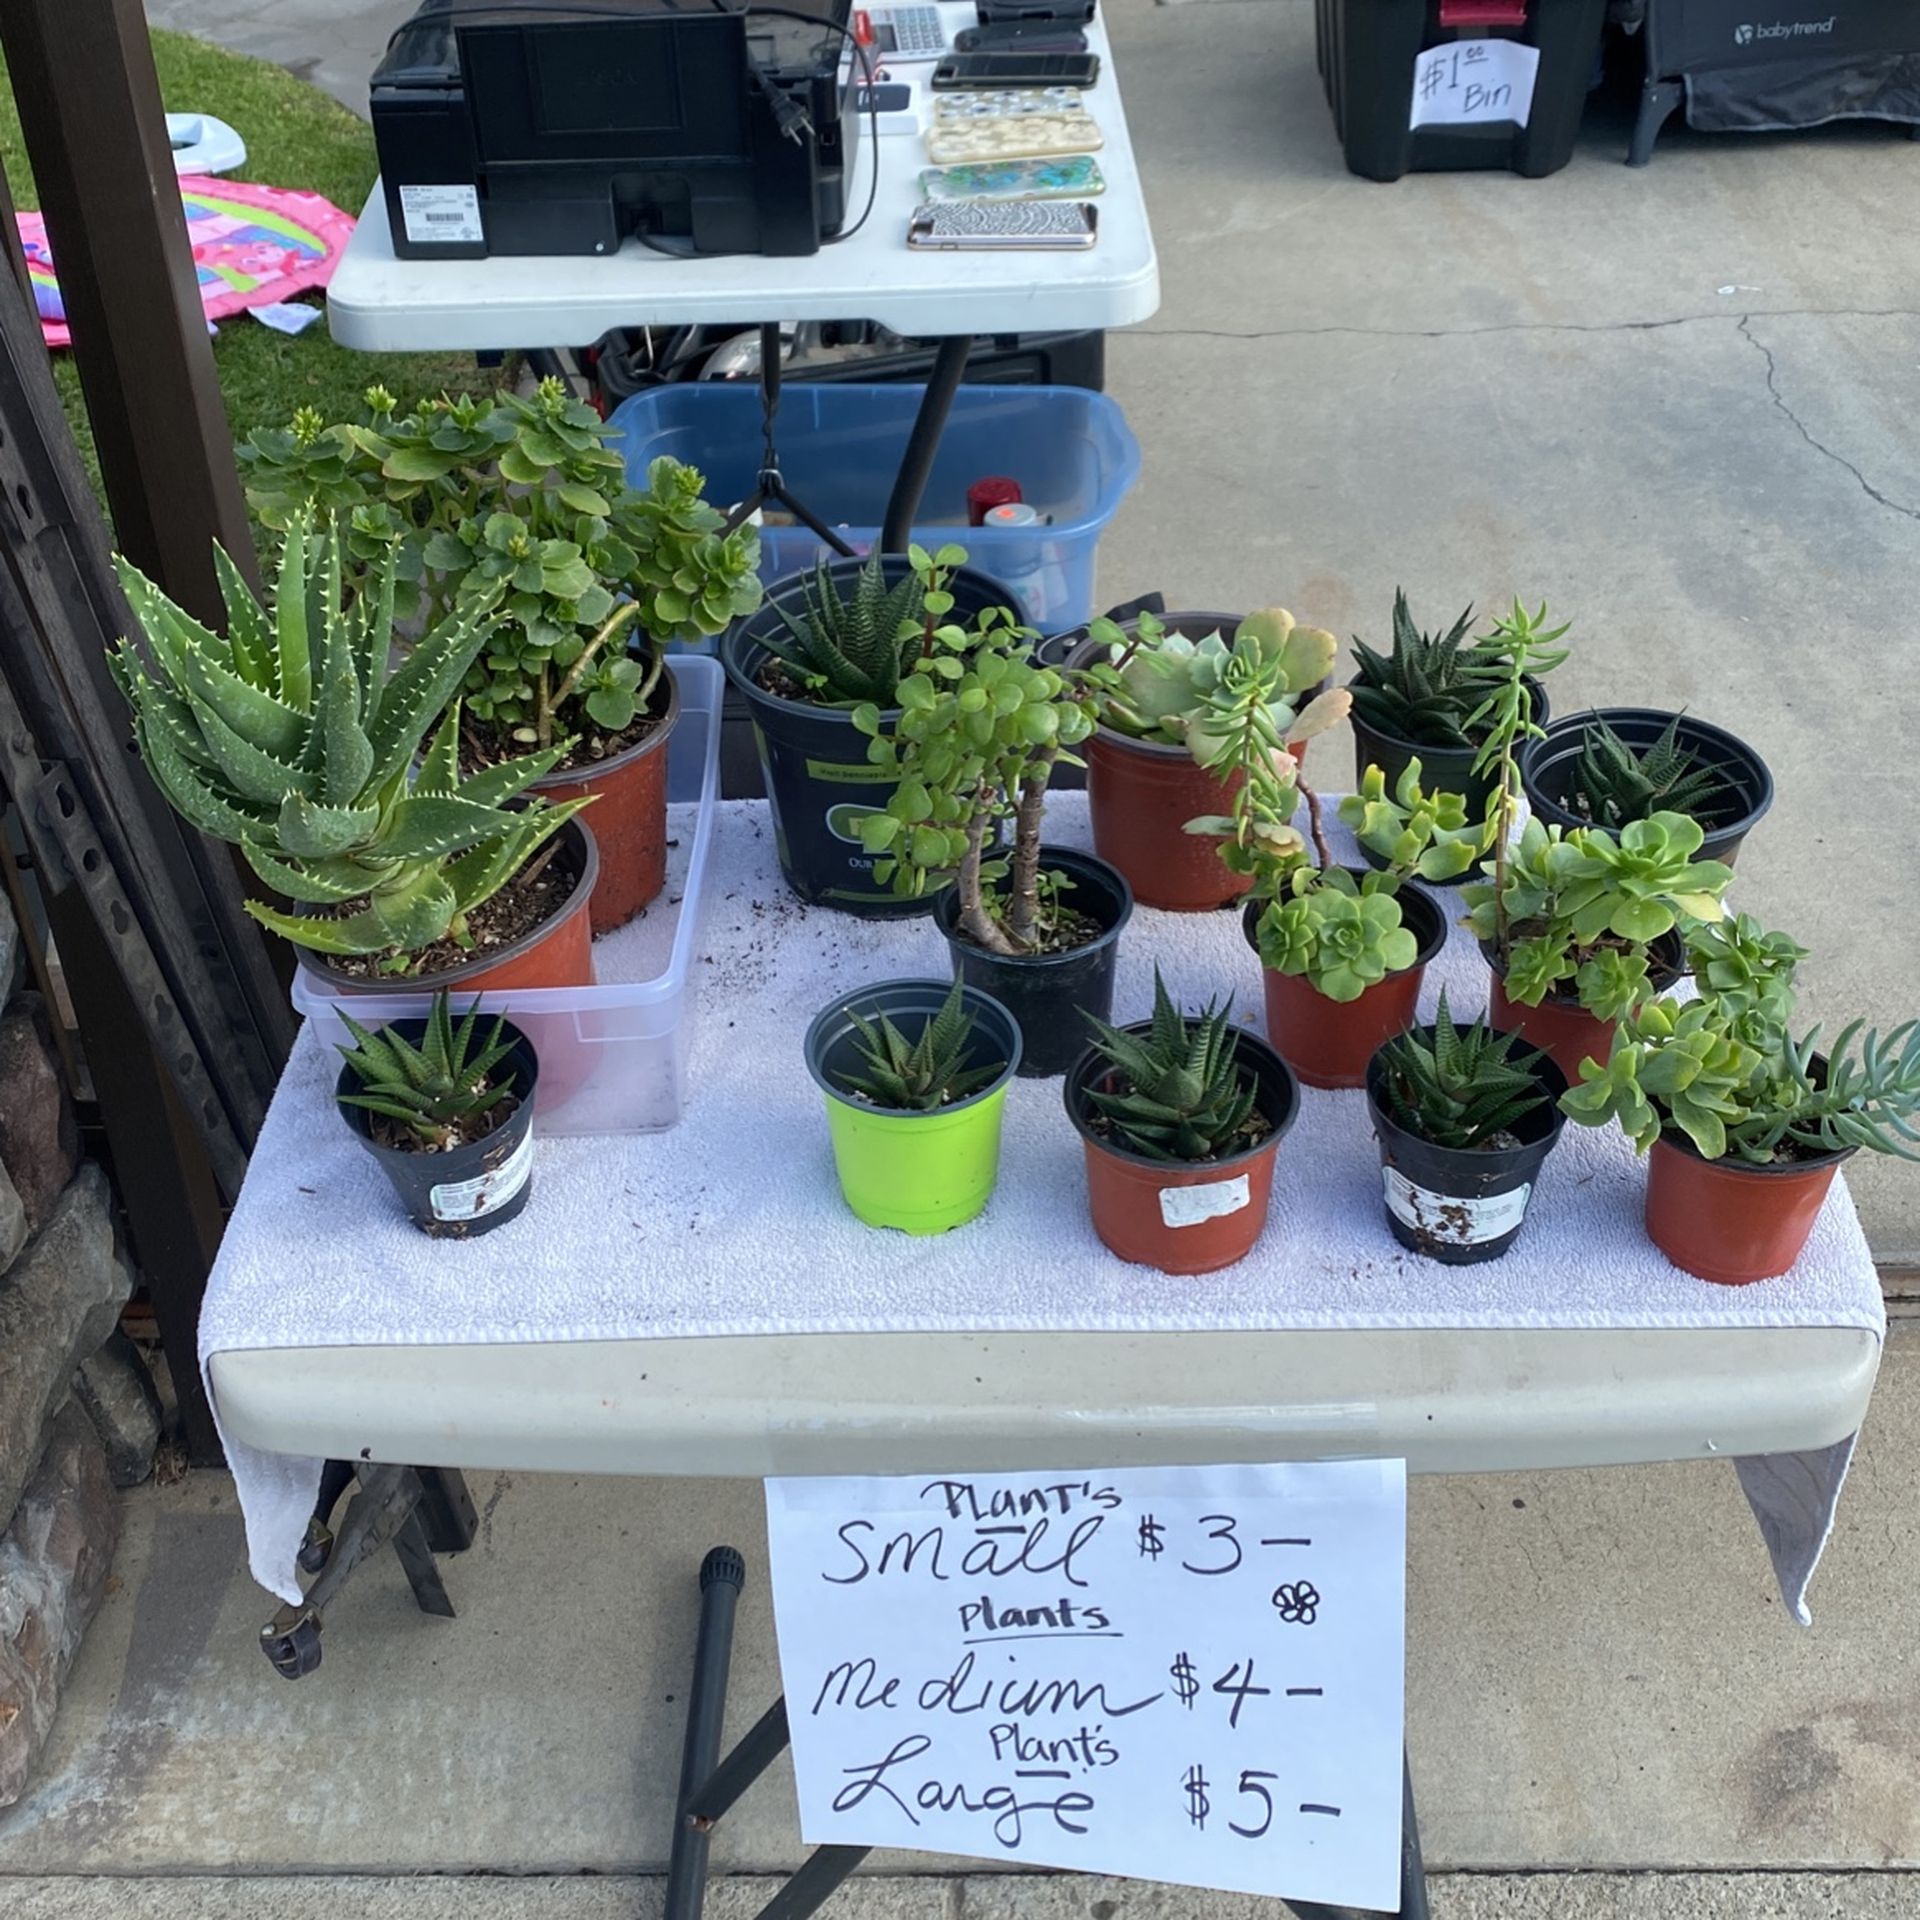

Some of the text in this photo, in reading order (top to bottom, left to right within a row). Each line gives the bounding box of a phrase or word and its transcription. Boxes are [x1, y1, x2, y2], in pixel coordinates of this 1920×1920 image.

[1757, 17, 1836, 40] babytrend
[1463, 78, 1512, 113] Bin
[822, 1515, 1105, 1587] Small
[812, 1651, 1164, 1717] Medium
[832, 1734, 1095, 1849] Large
